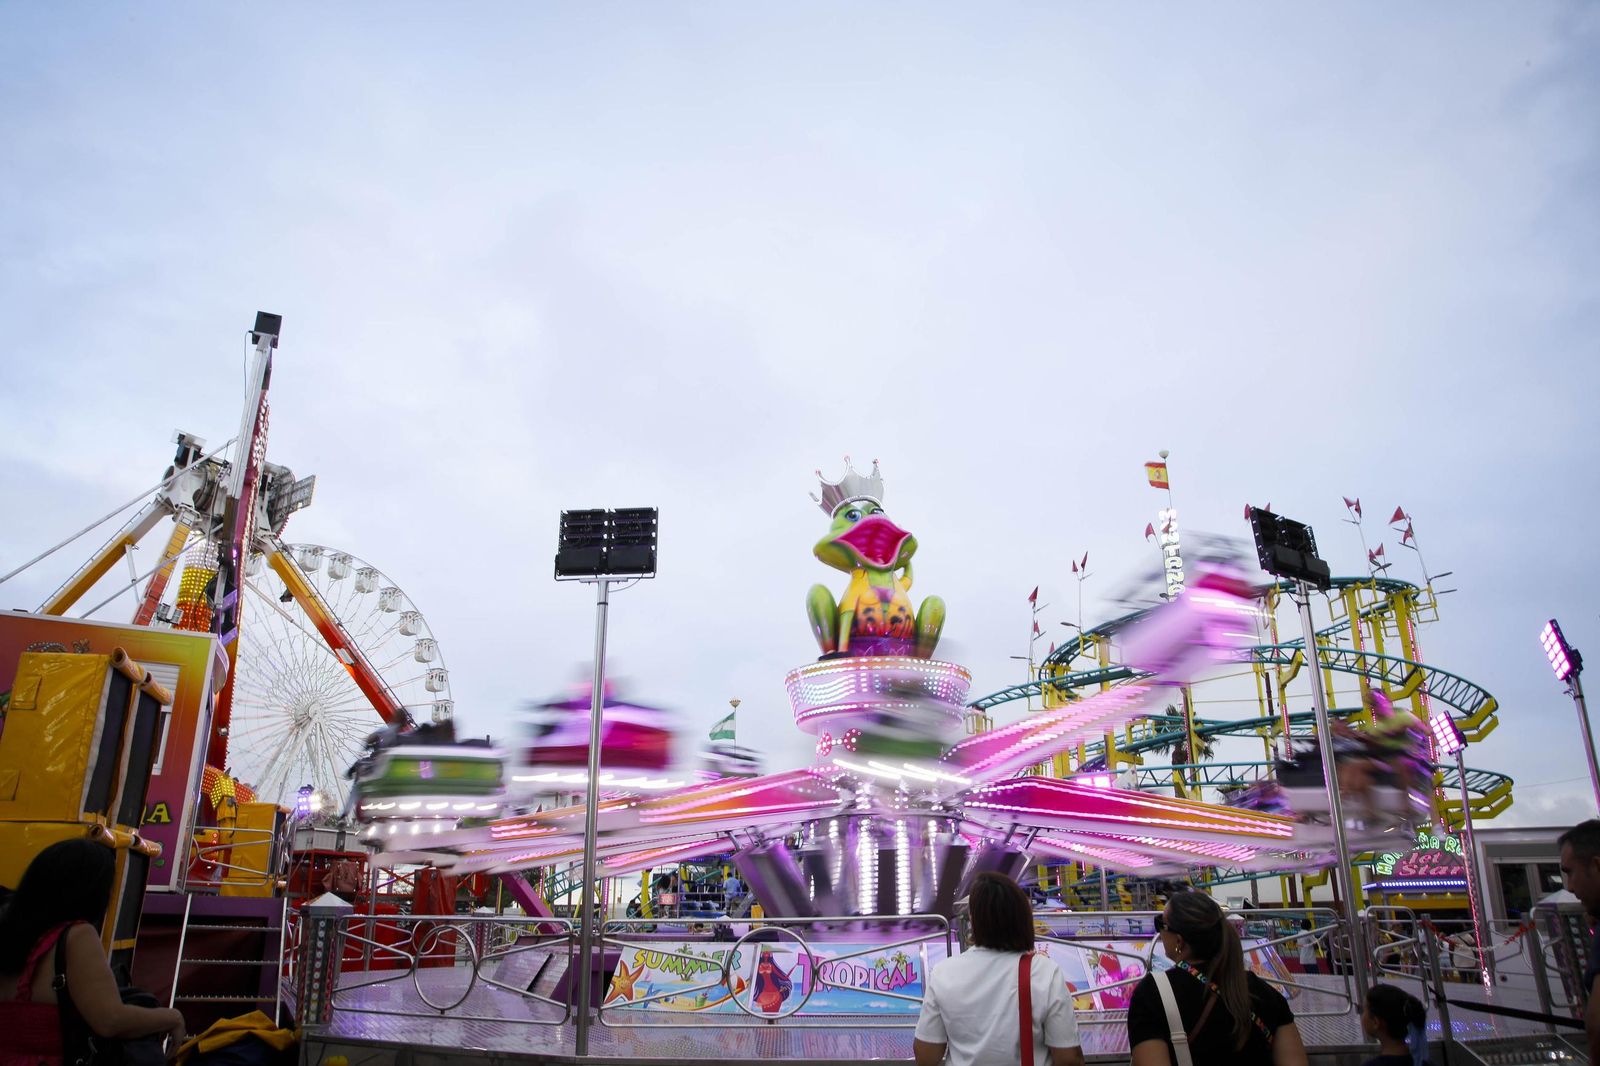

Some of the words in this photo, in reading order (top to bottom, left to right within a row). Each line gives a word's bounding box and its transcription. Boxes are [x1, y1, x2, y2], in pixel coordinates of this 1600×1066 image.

[1403, 852, 1442, 865] Jet
[1399, 864, 1464, 875] Star
[632, 949, 742, 975] SUMMER
[797, 953, 918, 996] TROPICAL
